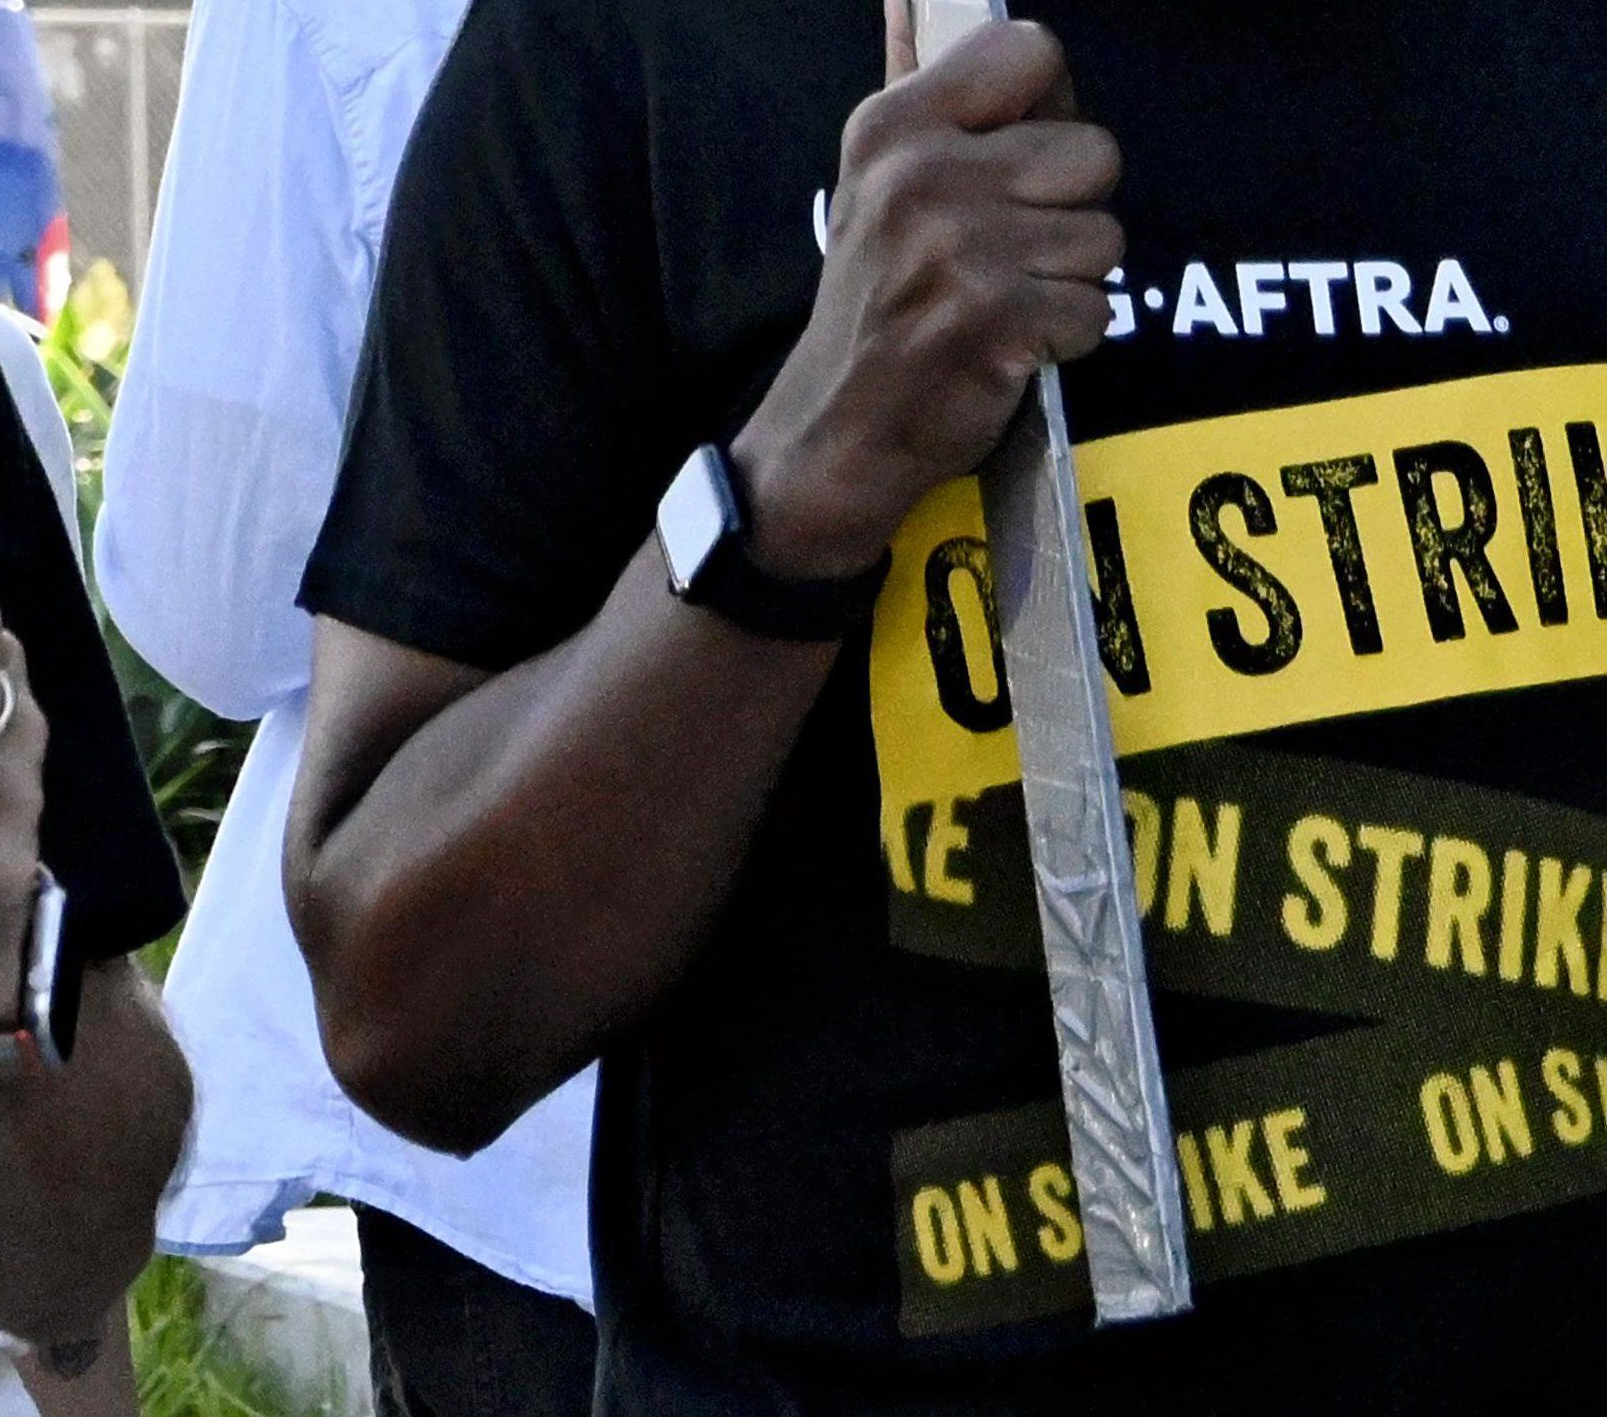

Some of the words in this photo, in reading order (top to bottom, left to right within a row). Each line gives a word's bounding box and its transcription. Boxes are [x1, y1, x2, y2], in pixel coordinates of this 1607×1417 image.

[1282, 814, 1607, 1003] STRIK
[912, 1174, 1019, 1284] ON
[1029, 1108, 1326, 1262] SIKE
[1420, 1056, 1533, 1176] ON
